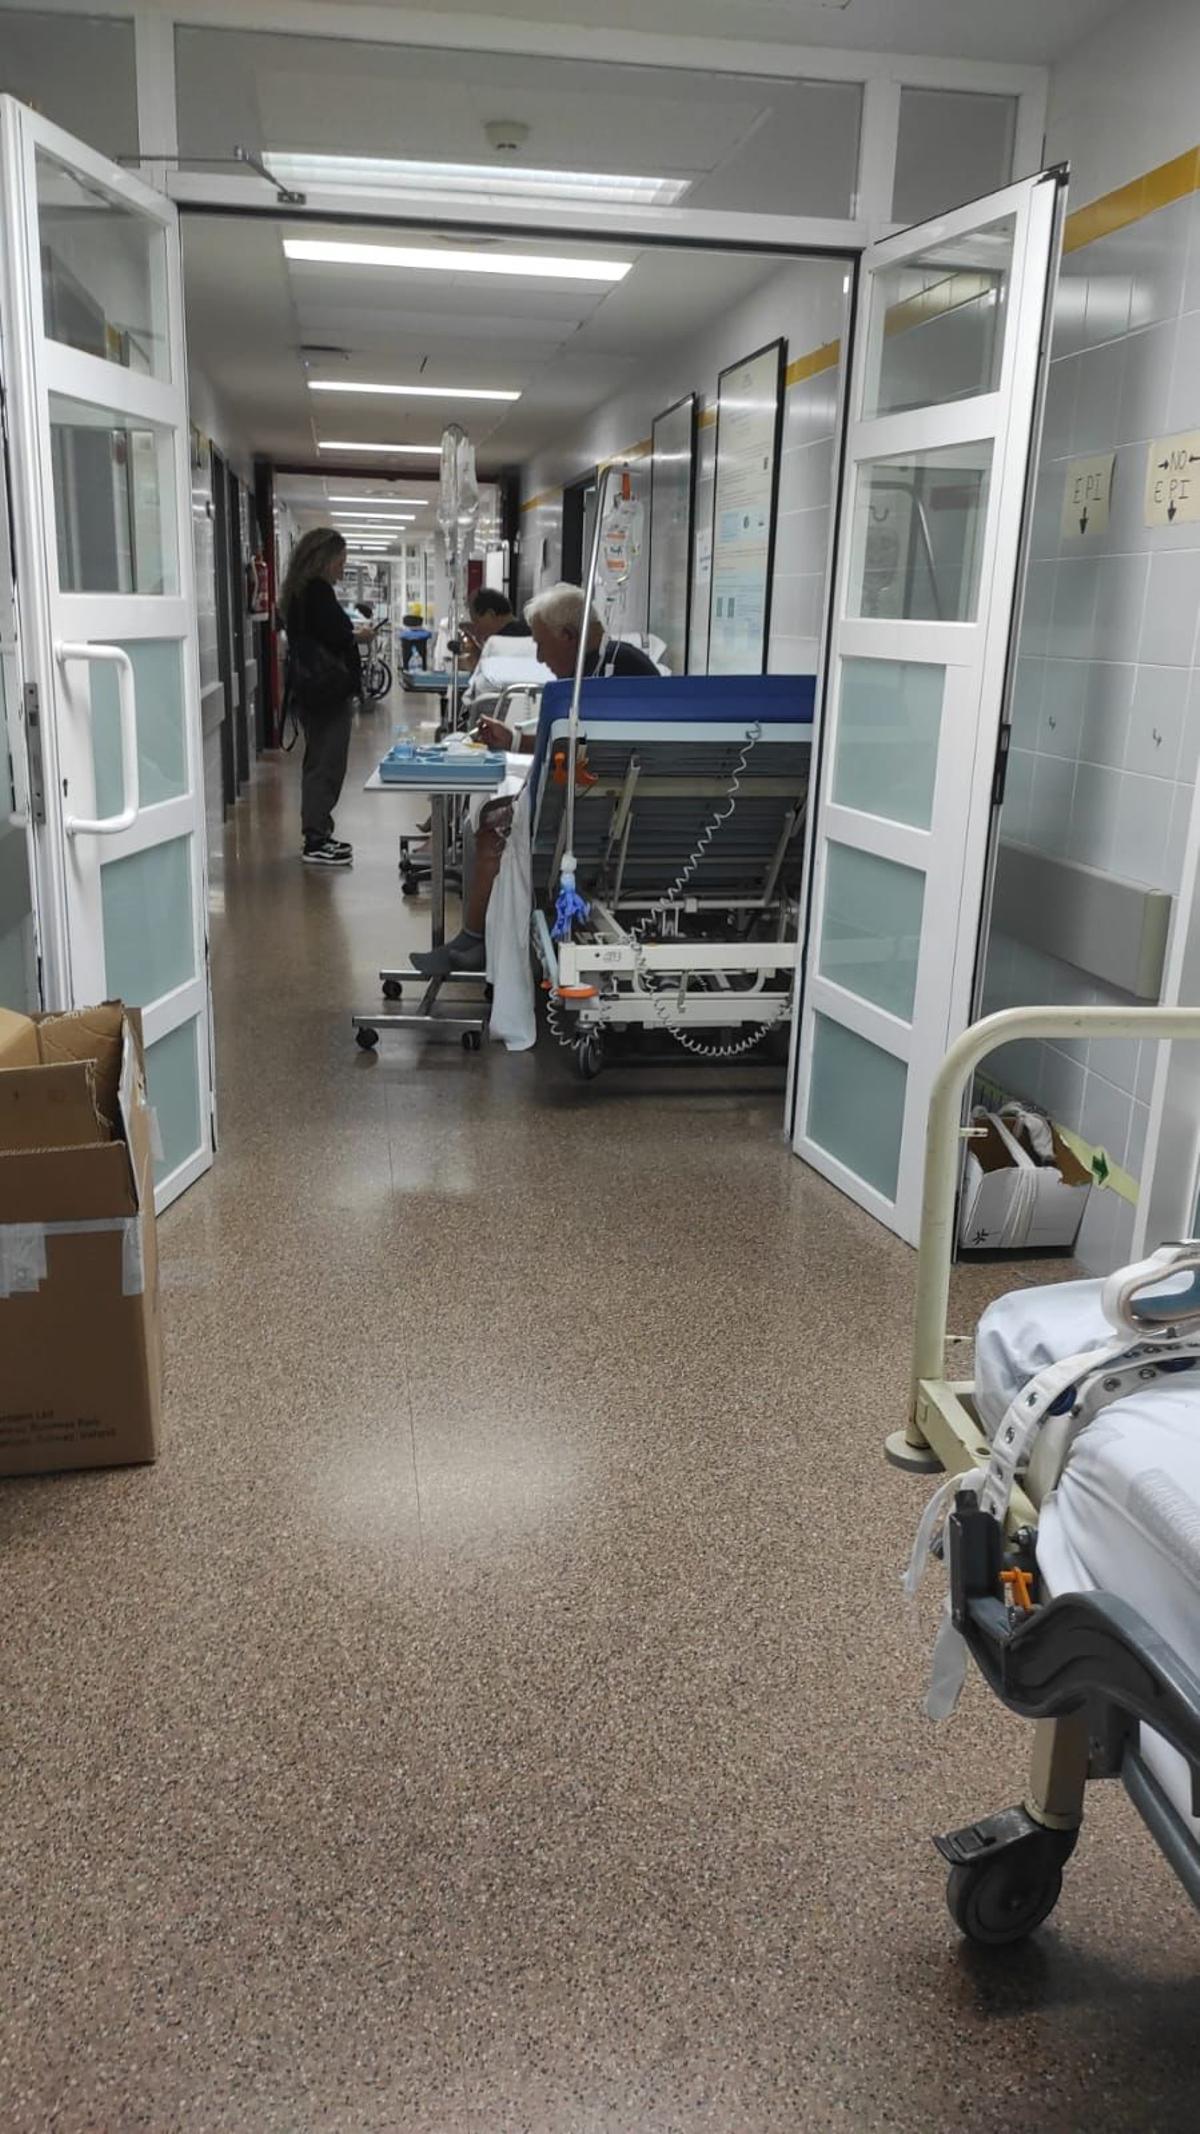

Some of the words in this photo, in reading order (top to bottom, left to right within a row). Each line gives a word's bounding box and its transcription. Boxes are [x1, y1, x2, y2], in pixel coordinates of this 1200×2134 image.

[1170, 449, 1188, 470] NO
[1072, 472, 1102, 504] EPI
[1154, 479, 1190, 503] EPI
